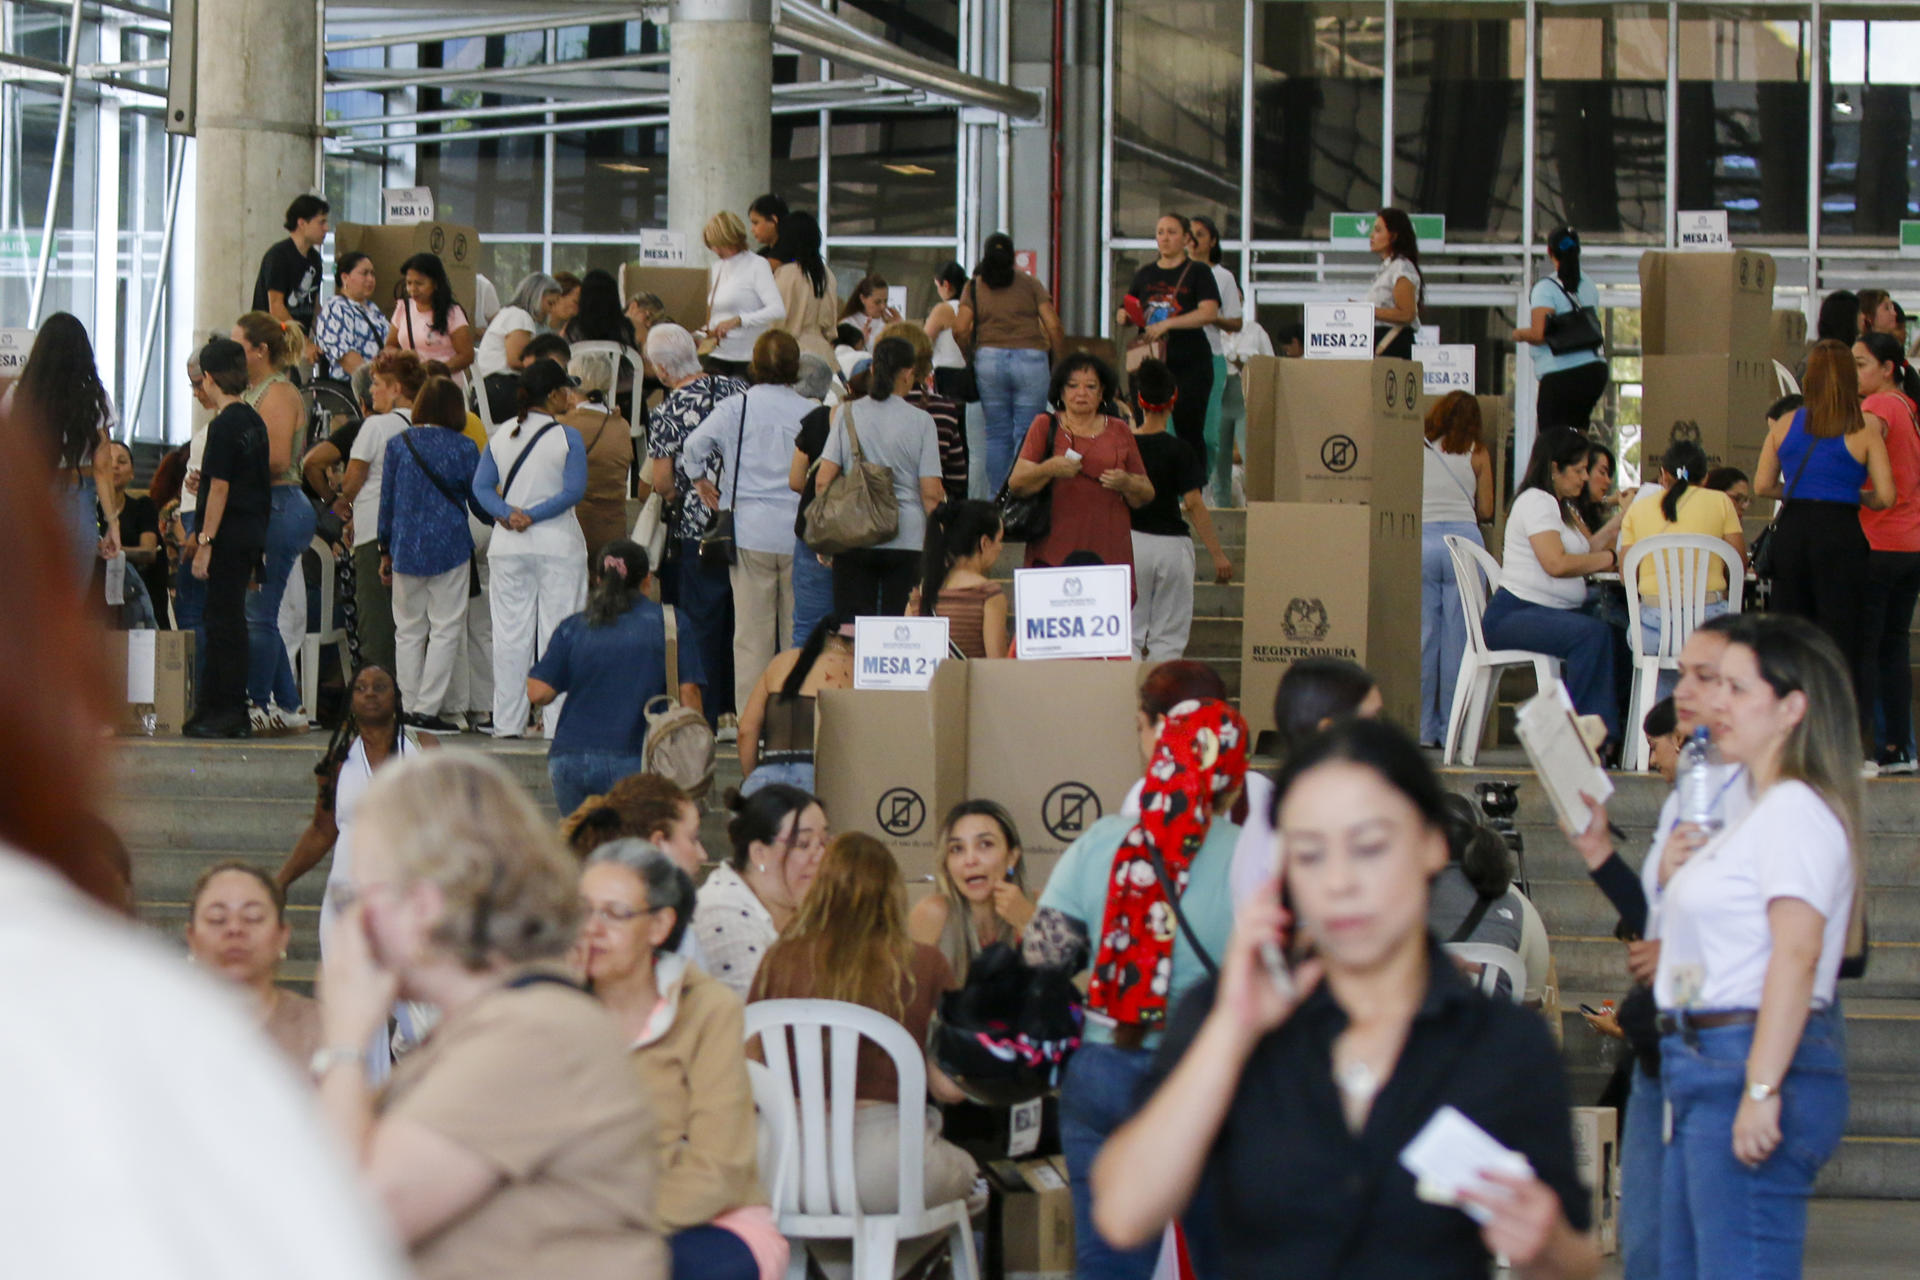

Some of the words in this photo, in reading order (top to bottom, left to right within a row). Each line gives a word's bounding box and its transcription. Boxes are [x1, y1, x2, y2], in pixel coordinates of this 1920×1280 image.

[391, 205, 415, 216] MESA
[418, 206, 430, 216] 10
[1683, 233, 1708, 243] MESA
[1710, 233, 1723, 244] 24
[644, 249, 669, 259] MESA
[672, 250, 683, 260] 11
[1310, 333, 1347, 347] MESA
[1349, 333, 1368, 348] 22
[1452, 371, 1470, 385] 23
[1026, 615, 1086, 640] MESA
[1090, 615, 1121, 637] 20
[862, 656, 911, 675] MESA
[914, 656, 939, 675] 21
